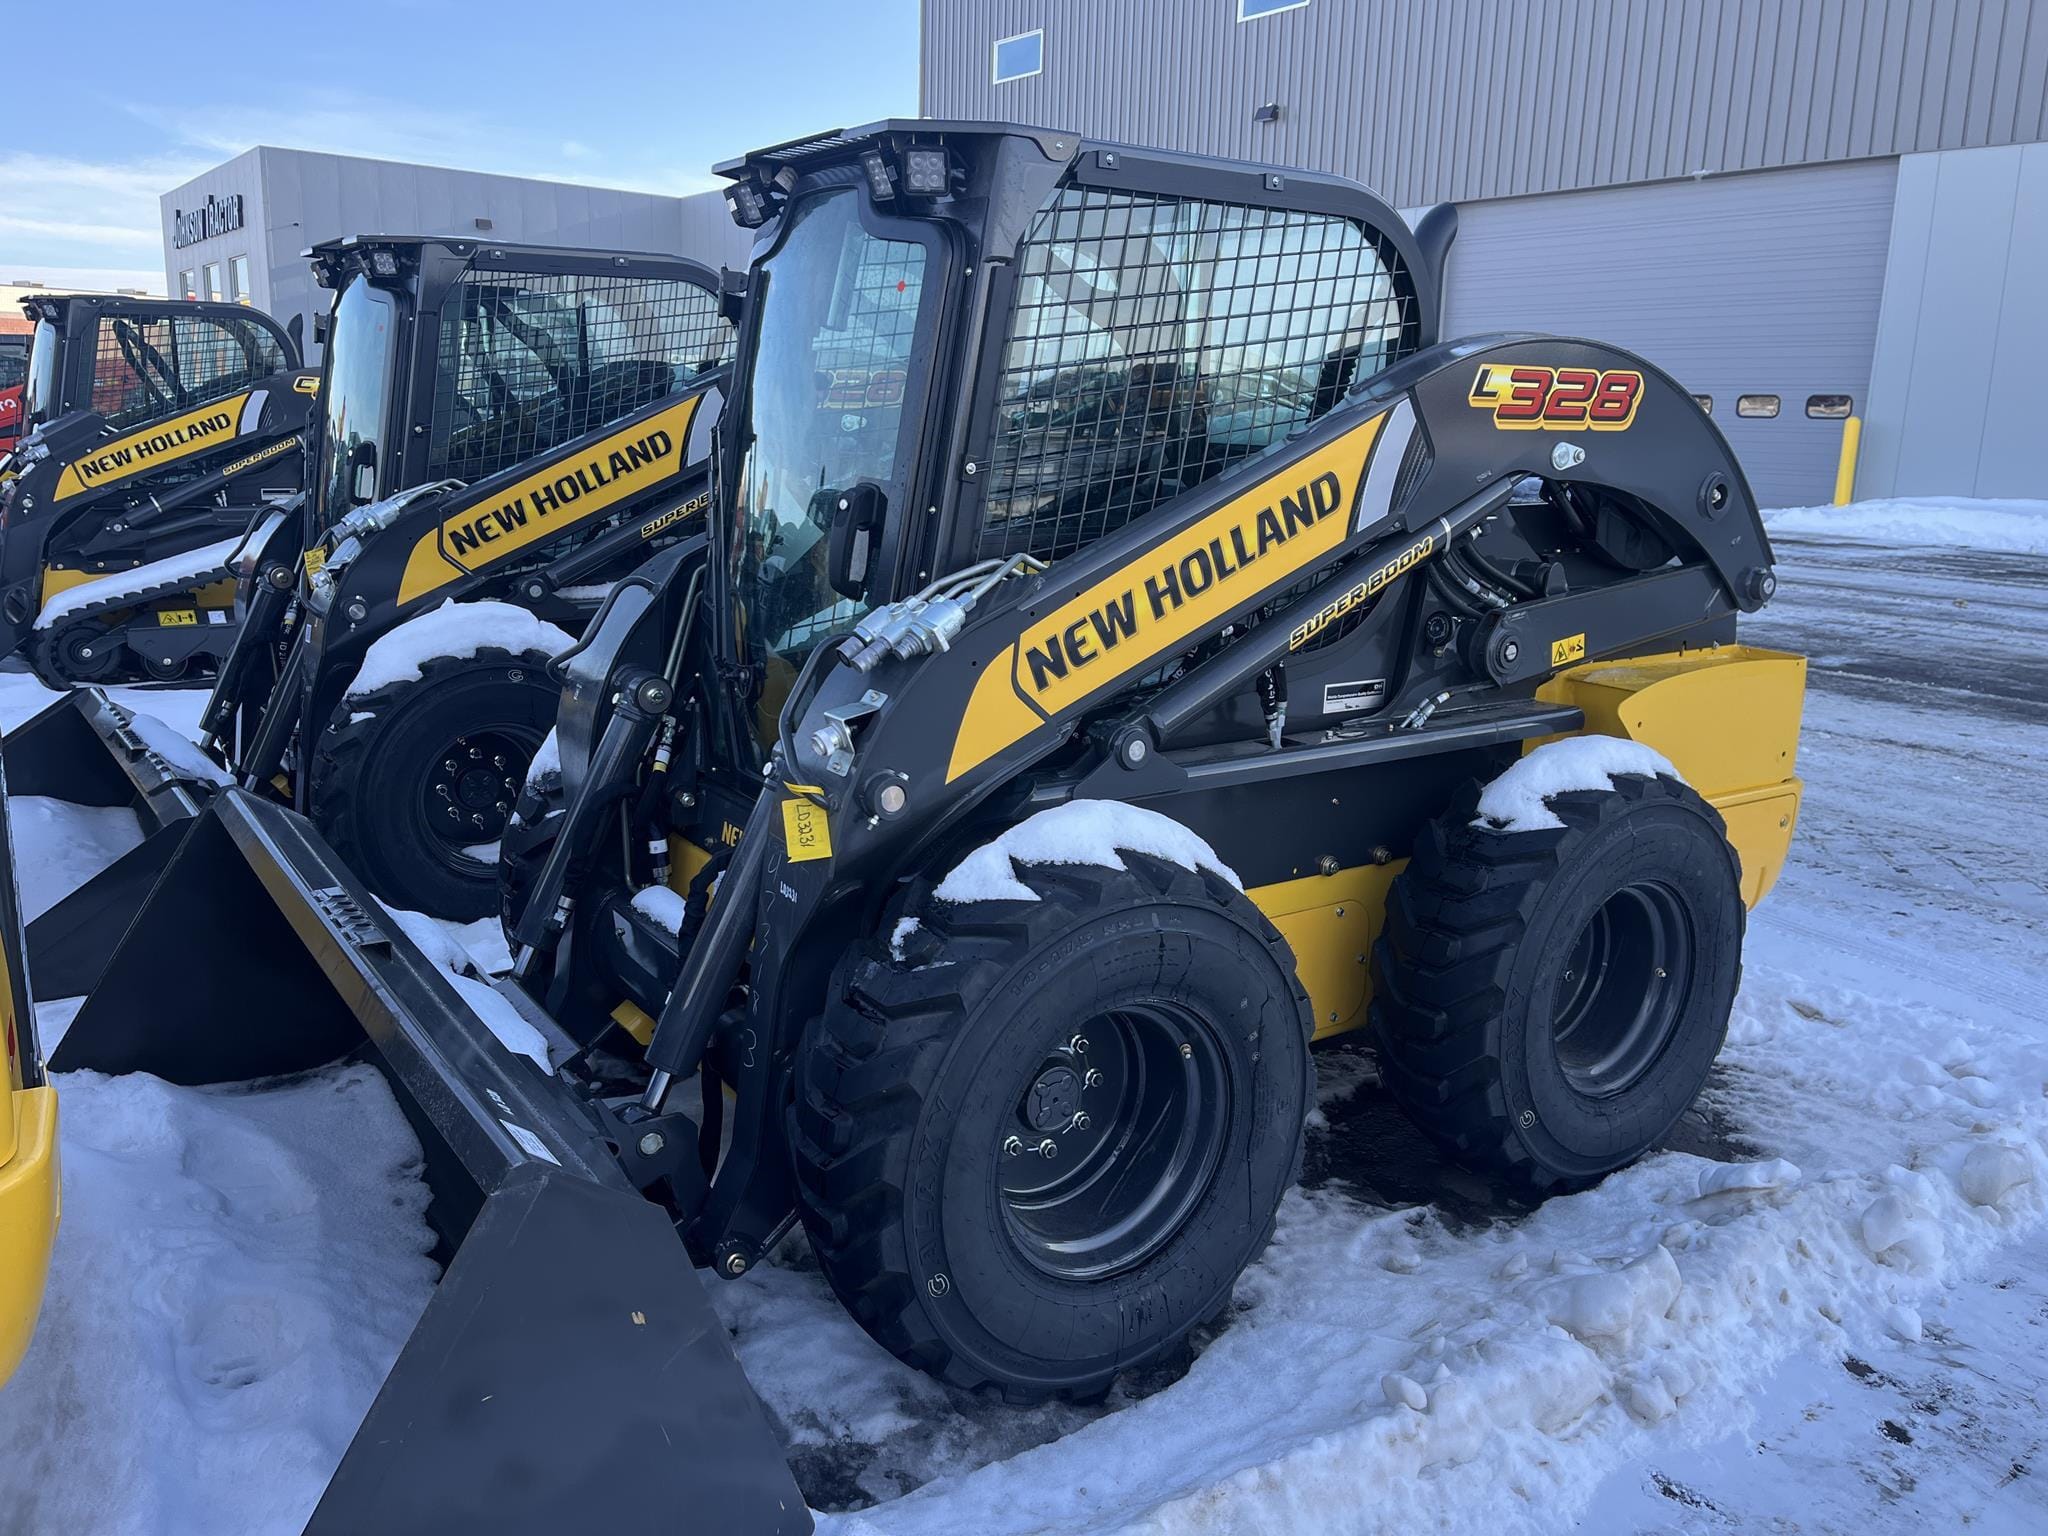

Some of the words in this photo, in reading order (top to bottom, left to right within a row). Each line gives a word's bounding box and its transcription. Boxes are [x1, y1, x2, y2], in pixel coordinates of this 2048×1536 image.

[172, 209, 207, 250] JOHNSON
[204, 194, 244, 238] TRACTOR
[1469, 364, 1645, 431] L328
[81, 447, 132, 479] NEW
[134, 412, 231, 459] HOLLAND
[223, 452, 262, 476] SUPER
[262, 437, 296, 458] BOOM
[447, 497, 528, 556] NEW
[529, 429, 673, 517] HOLLAND
[641, 497, 699, 539] SUPER
[1024, 588, 1138, 693] NEW
[1143, 470, 1343, 622] HOLLAND
[1289, 582, 1366, 652] SUPER
[1365, 536, 1434, 596] BOOM
[795, 803, 815, 848] LD3231
